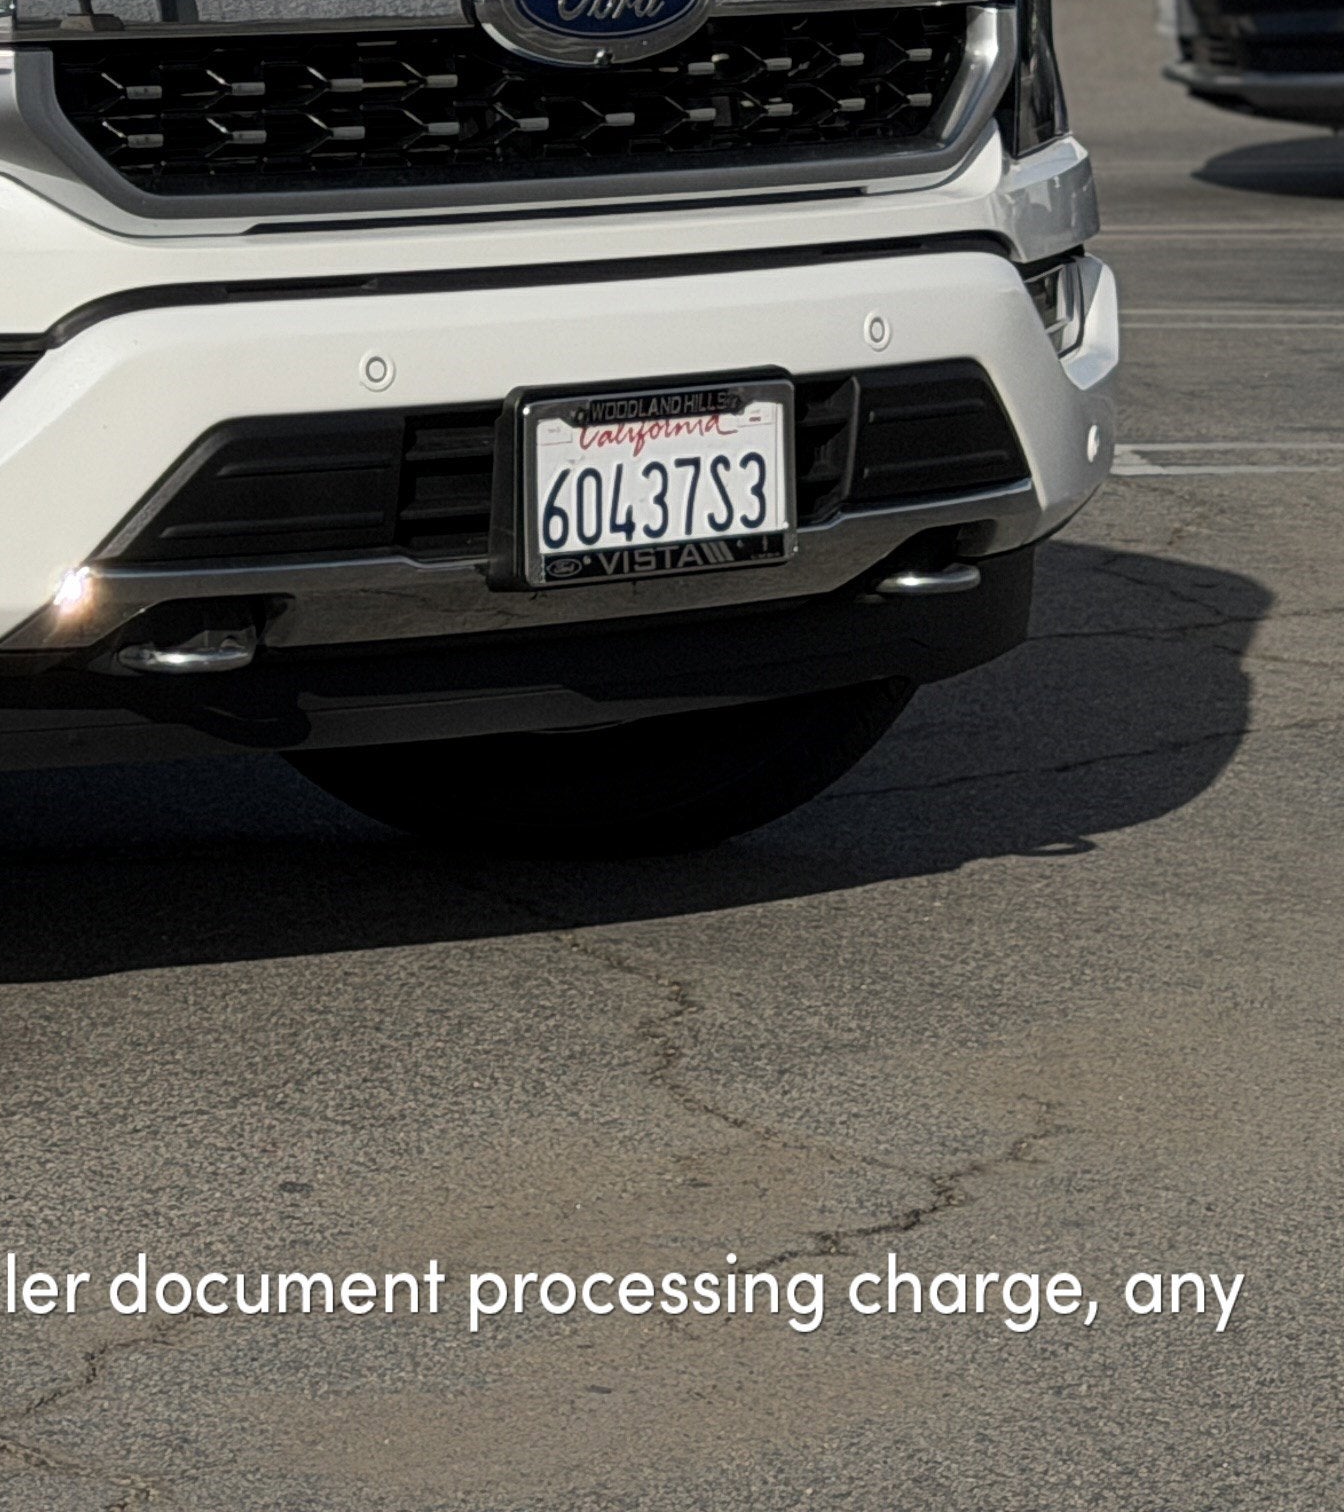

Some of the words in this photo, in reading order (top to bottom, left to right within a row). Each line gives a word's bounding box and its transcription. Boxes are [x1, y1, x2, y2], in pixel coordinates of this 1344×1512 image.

[591, 395, 682, 420] WOODLAND
[683, 394, 728, 414] HILLS
[579, 414, 739, 457] California
[543, 452, 767, 549] 60437S3
[597, 543, 703, 575] VISTA
